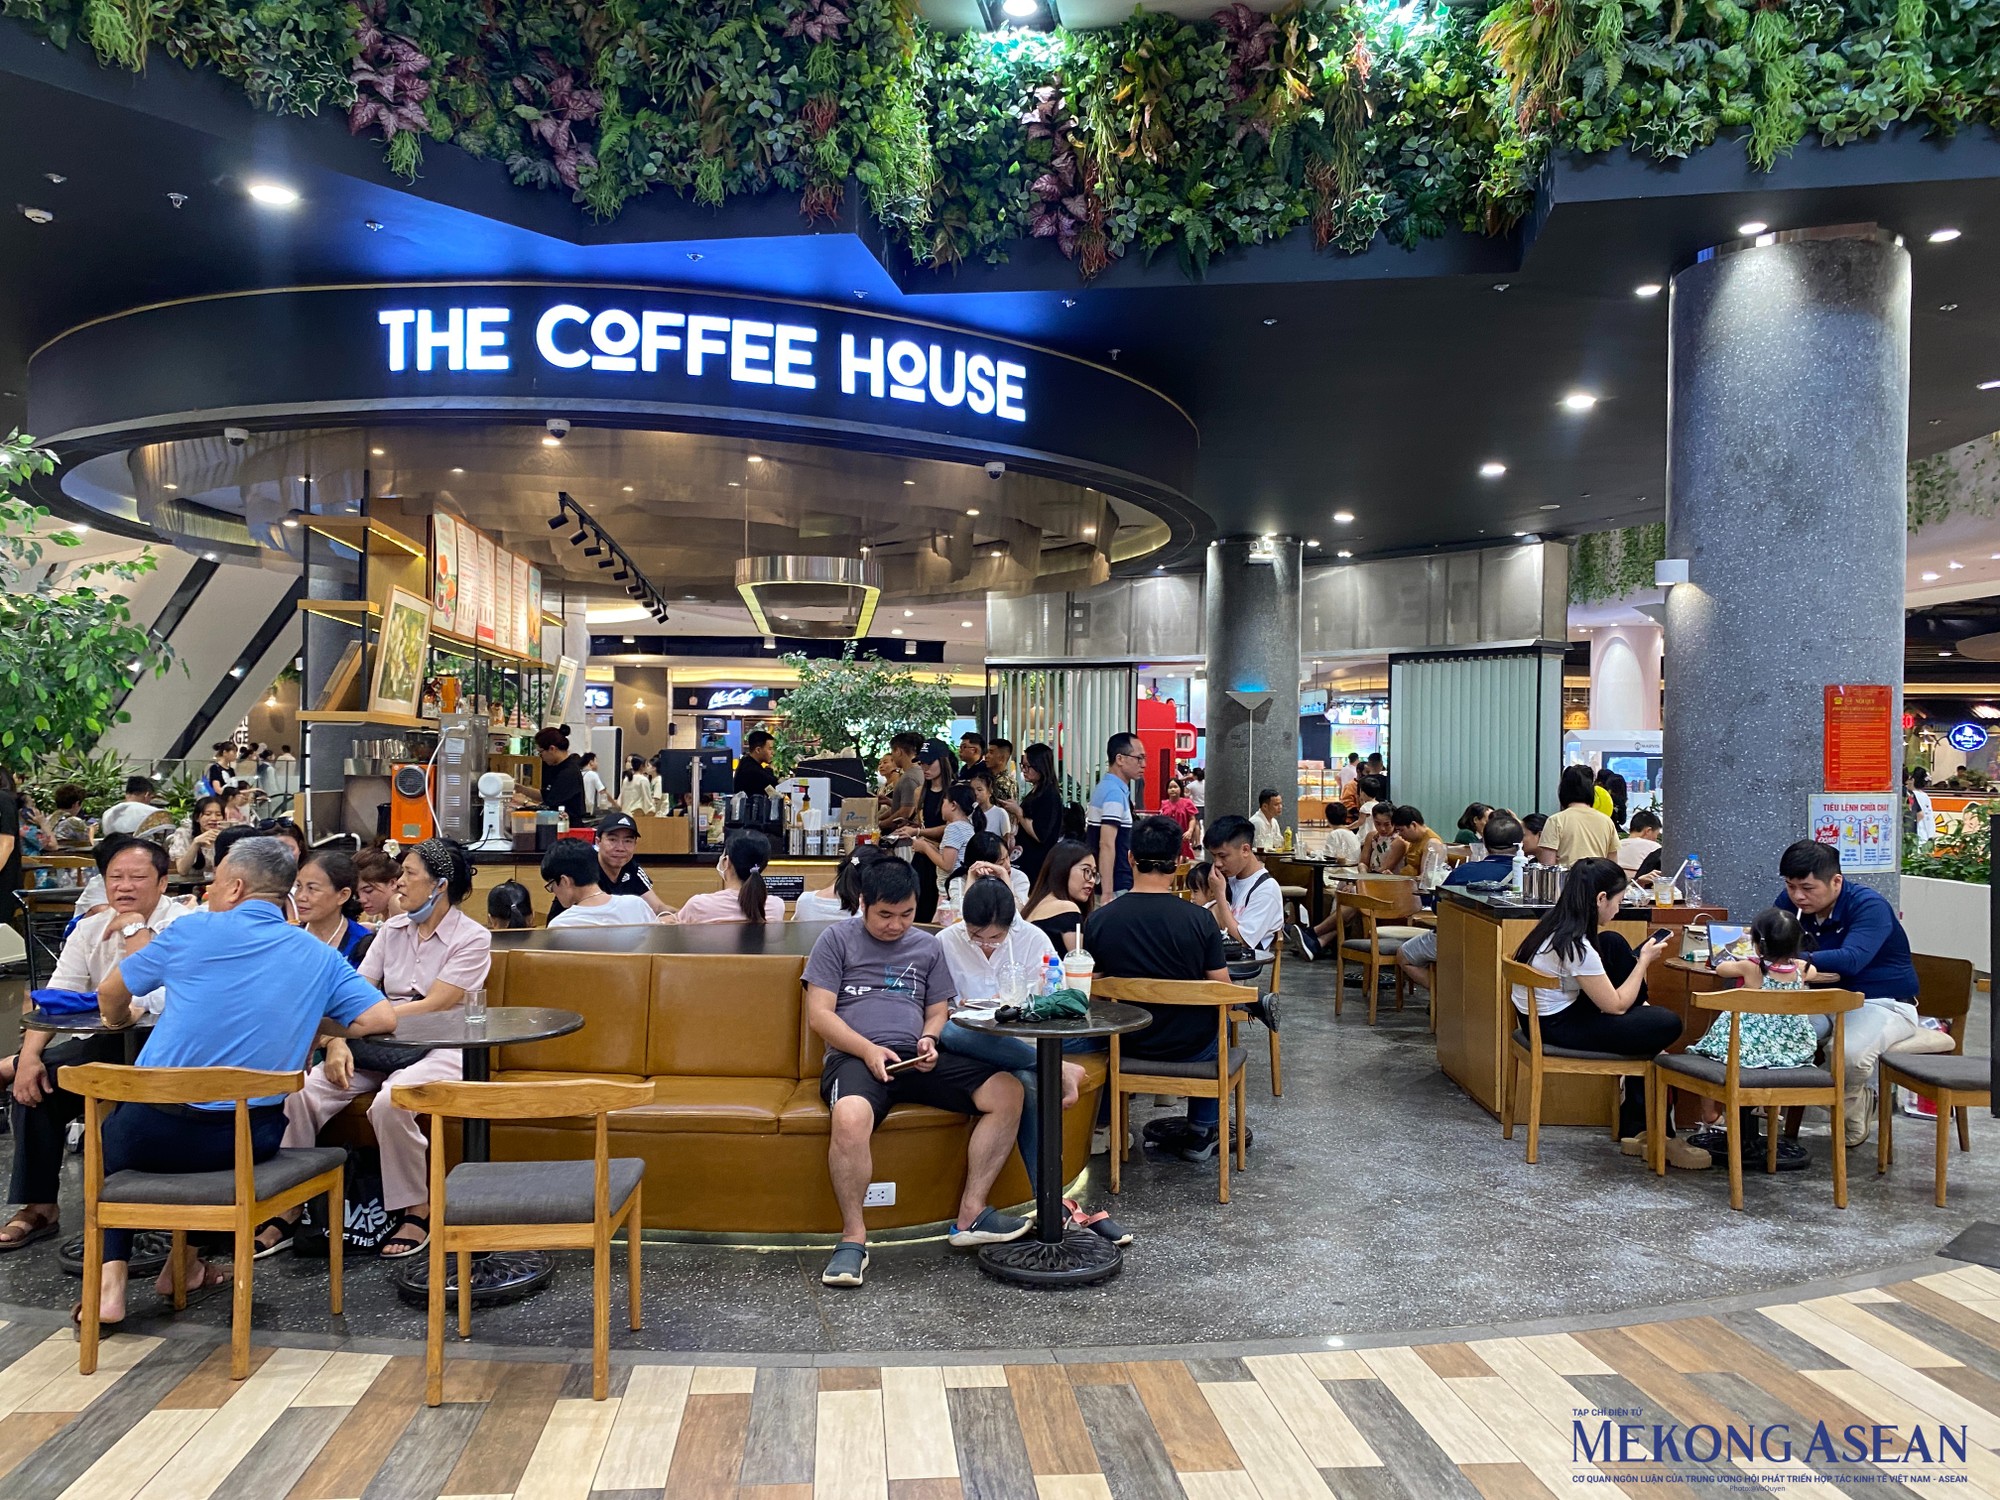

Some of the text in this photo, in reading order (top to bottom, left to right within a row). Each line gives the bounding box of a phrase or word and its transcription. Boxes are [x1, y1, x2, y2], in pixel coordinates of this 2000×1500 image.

[378, 303, 1027, 423] THE COFFEE HOUSE
[352, 1234, 375, 1247] THE
